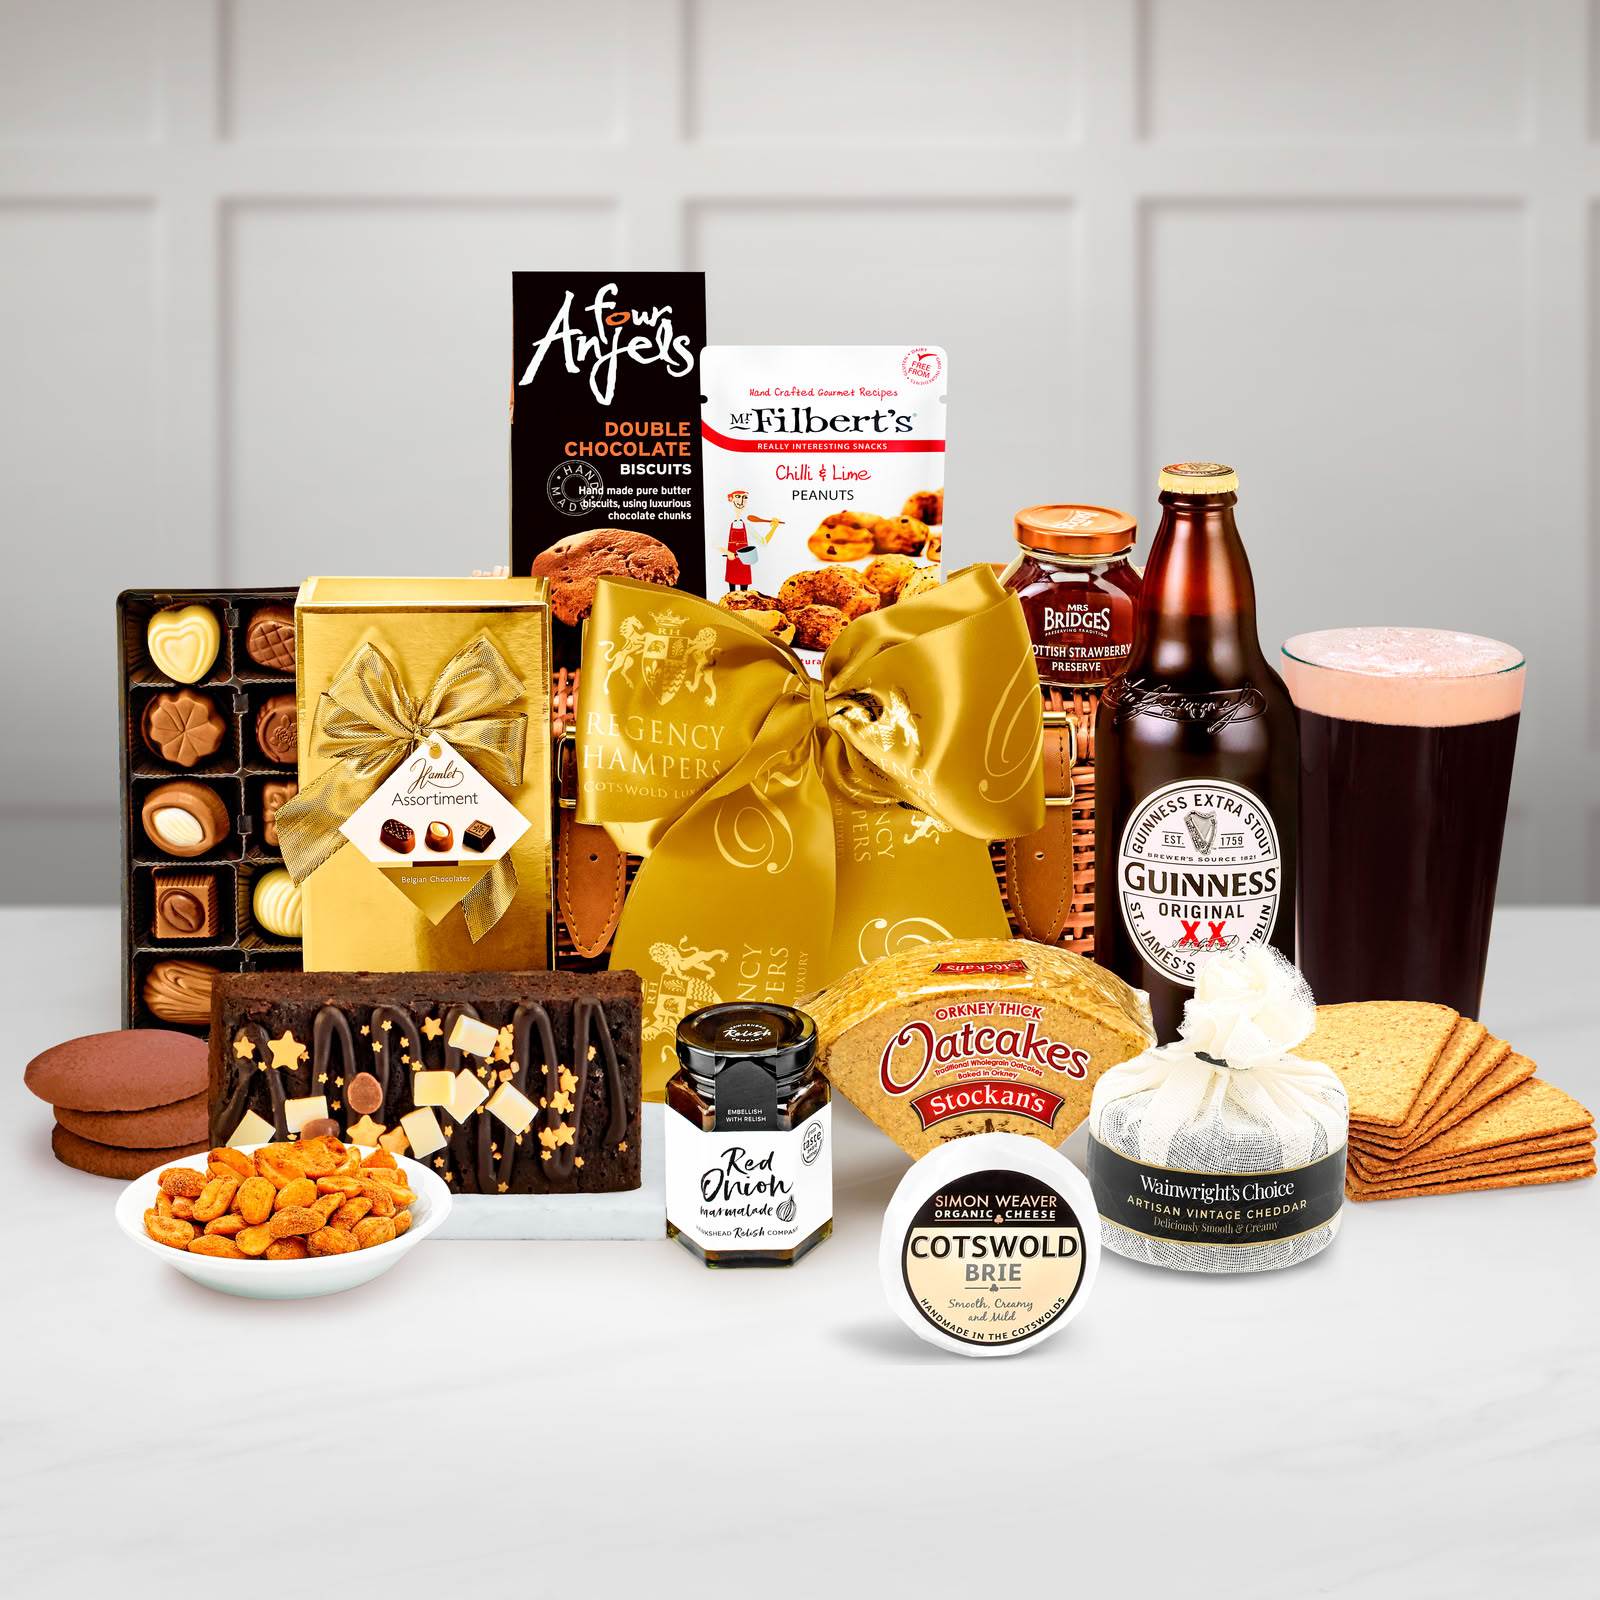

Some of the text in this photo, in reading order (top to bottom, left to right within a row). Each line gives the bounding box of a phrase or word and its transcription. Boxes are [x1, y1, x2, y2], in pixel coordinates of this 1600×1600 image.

[585, 283, 673, 344] four
[908, 368, 930, 378] FROM
[912, 361, 930, 371] FREE
[750, 386, 898, 401] Hand Crafted Gourmet Recipes
[752, 407, 913, 433] Filbert's
[605, 421, 691, 437] DOUBLE
[564, 441, 691, 457] CHOCOLATE
[563, 464, 599, 490] HAND
[620, 463, 692, 475] BISCUITS
[776, 464, 871, 481] Chilli & Lime
[578, 486, 691, 497] Hand made pure butter
[792, 490, 854, 500] PEANUTS
[582, 499, 691, 510] biscuits, using luxurious
[608, 511, 691, 520] chocolate chunks
[1044, 607, 1110, 631] BRIDGES
[657, 627, 681, 636] RH
[1045, 628, 1108, 638] PRESERVING TRADITION
[1032, 644, 1132, 657] OTTISH STRAWBERRY
[1052, 662, 1101, 671] PRESERVE
[587, 712, 724, 751] REGENCY
[583, 745, 721, 780] HAMPERS
[408, 758, 464, 794] Hamlet
[584, 781, 667, 798] COTSWOLD
[392, 793, 478, 806] Assortiment
[1132, 794, 1271, 857] GUINNESS EXTRA STOUT
[1164, 834, 1243, 846] EST. 1759
[1148, 853, 1194, 862] BREWER'S
[402, 875, 470, 885] Belgian Chocolates
[1124, 862, 1276, 897] GUINNESS
[1159, 902, 1245, 918] ORIGINAL
[1130, 902, 1144, 927] ST.
[1141, 929, 1195, 975] JAMES'S
[1247, 905, 1271, 945] BLIN
[935, 1002, 1042, 1021] ORKNEY THICK
[723, 1029, 771, 1037] Relish
[881, 1021, 1089, 1095] Oatcakes
[935, 1059, 1043, 1076] Traditional Wholegrain Oatcakes
[958, 1071, 981, 1080] Baked
[991, 1070, 1018, 1079] Orkney
[930, 1085, 1046, 1115] Stockan's
[803, 1131, 821, 1150] taste
[721, 1147, 774, 1175] Red
[701, 1167, 793, 1202] Onion
[1140, 1174, 1295, 1204] Wainwright's Choice
[935, 1195, 1057, 1207] SIMON WEAVER
[1127, 1195, 1308, 1220] ARTISAN VINTAGE CHEDDAR
[700, 1203, 773, 1218] marmalade
[935, 1210, 1056, 1218] ORGANIC CHEESE
[733, 1222, 764, 1238] Relish
[1154, 1216, 1280, 1234] Deliciously Smooth & Creamy
[911, 1236, 1079, 1258] COTSWOLD
[965, 1264, 1022, 1281] BRIE
[948, 1299, 1033, 1311] Smooth, Creamy
[921, 1298, 970, 1337] HANDMADE
[972, 1331, 985, 1340] IN
[1012, 1297, 1065, 1337] COTSWOLDS
[968, 1311, 1017, 1323] and Mild
